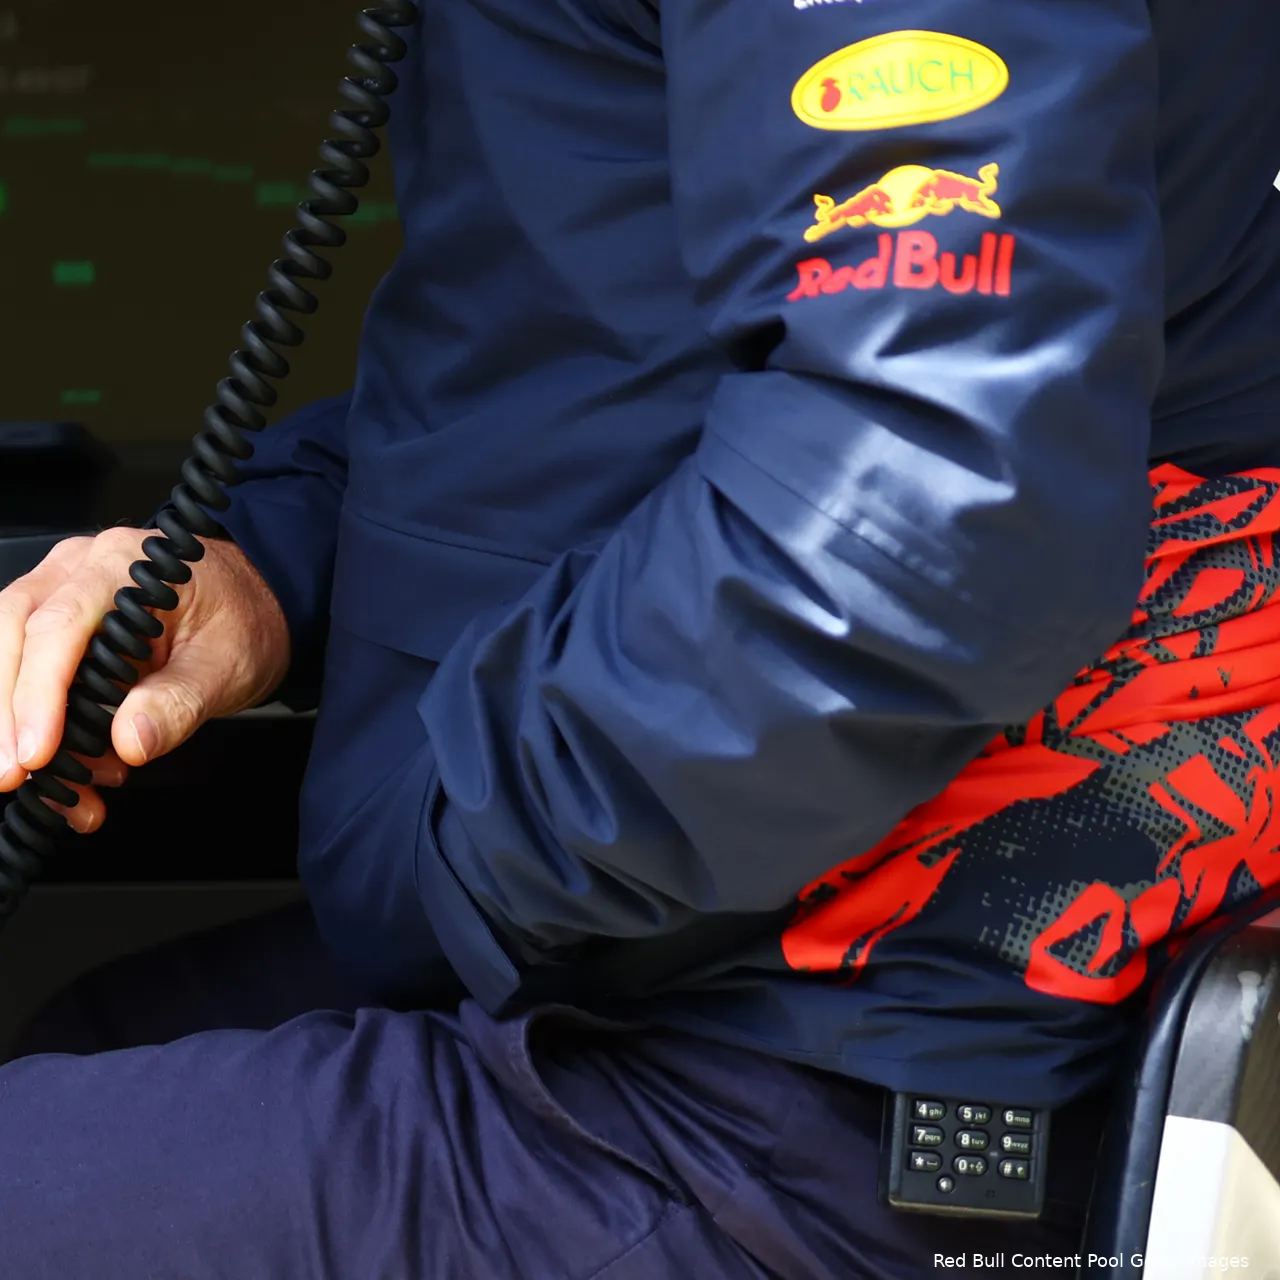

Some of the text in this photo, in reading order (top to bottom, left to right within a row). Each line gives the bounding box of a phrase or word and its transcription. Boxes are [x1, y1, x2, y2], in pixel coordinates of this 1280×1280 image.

[846, 59, 974, 102] RAUCH
[918, 1103, 928, 1116] 4
[963, 1107, 972, 1119] 5
[1005, 1110, 1014, 1122] 6
[916, 1129, 926, 1141] 7
[961, 1133, 970, 1145] 8
[1003, 1136, 1012, 1148] 9
